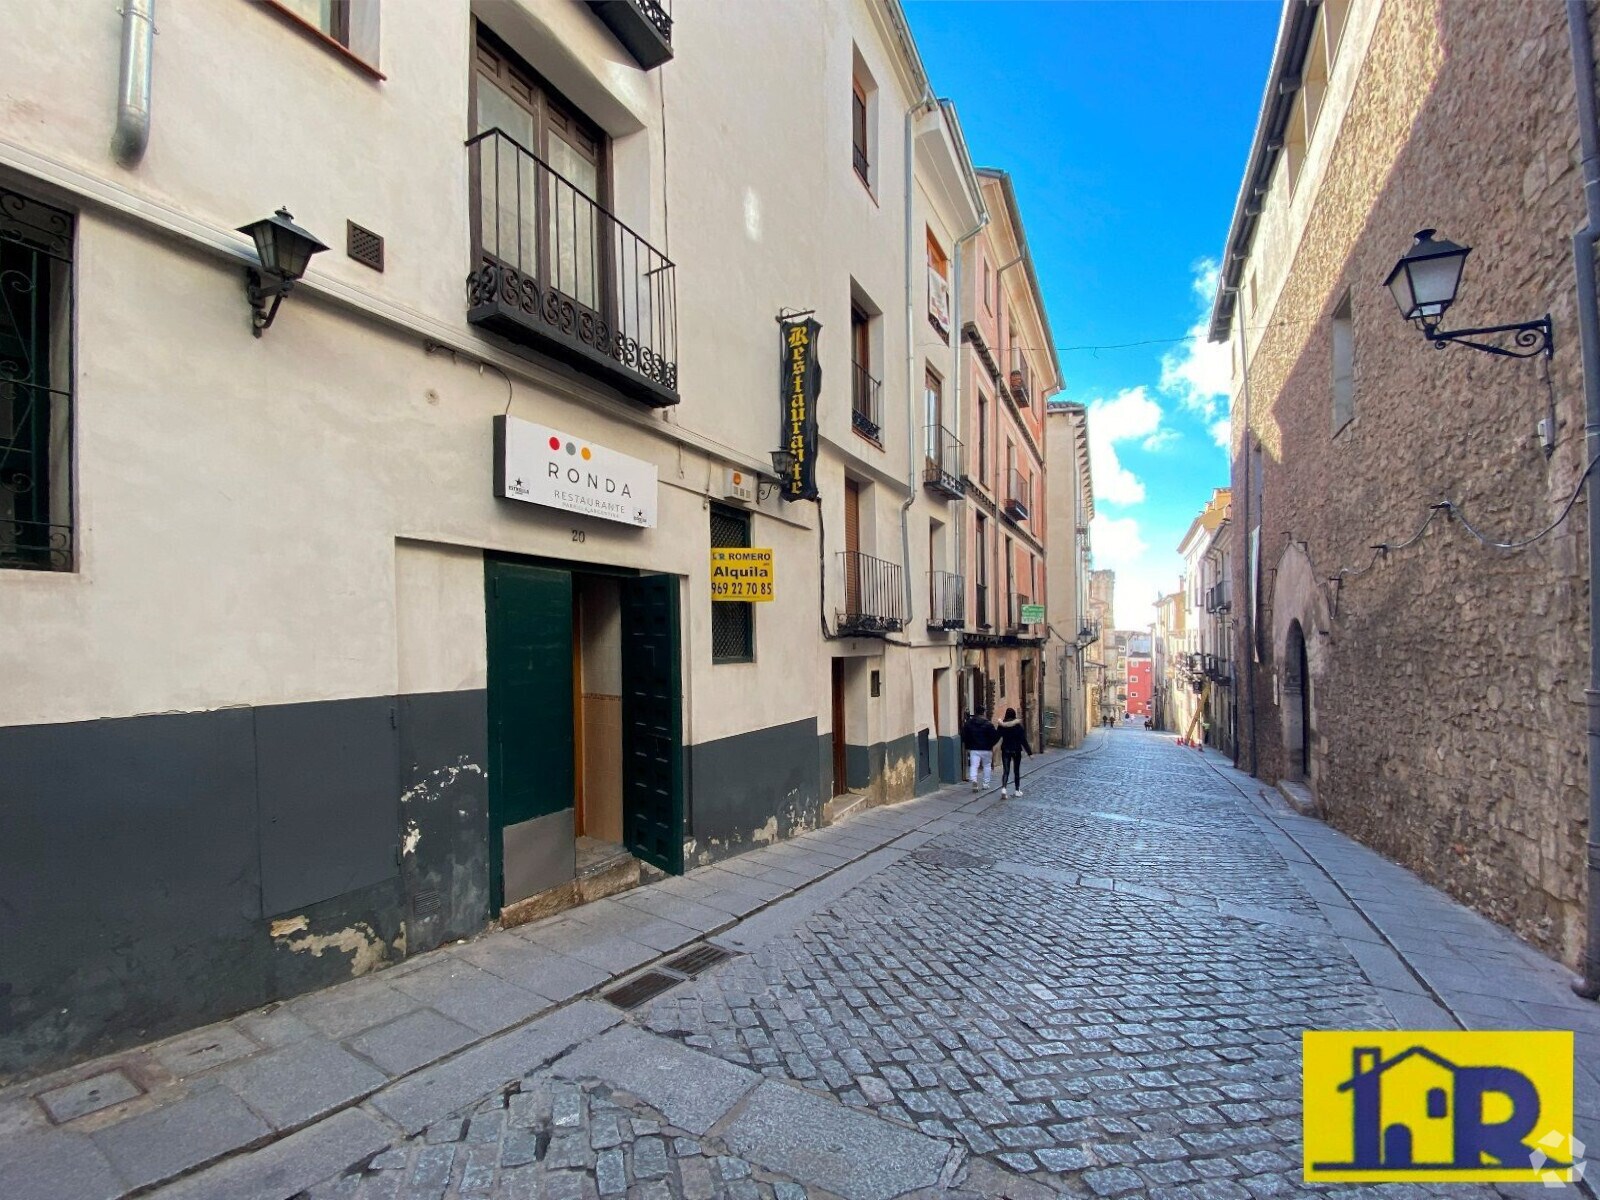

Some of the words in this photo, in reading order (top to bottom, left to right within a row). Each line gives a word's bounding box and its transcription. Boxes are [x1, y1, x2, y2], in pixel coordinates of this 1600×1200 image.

[548, 462, 632, 499] RONDA
[554, 489, 625, 514] RESTAURANTE
[571, 529, 586, 543] 20
[728, 552, 771, 561] ROMERO
[713, 566, 769, 580] Alquila
[711, 582, 729, 594] 969
[731, 582, 743, 595] 22
[746, 582, 758, 595] 70
[760, 582, 772, 595] 85
